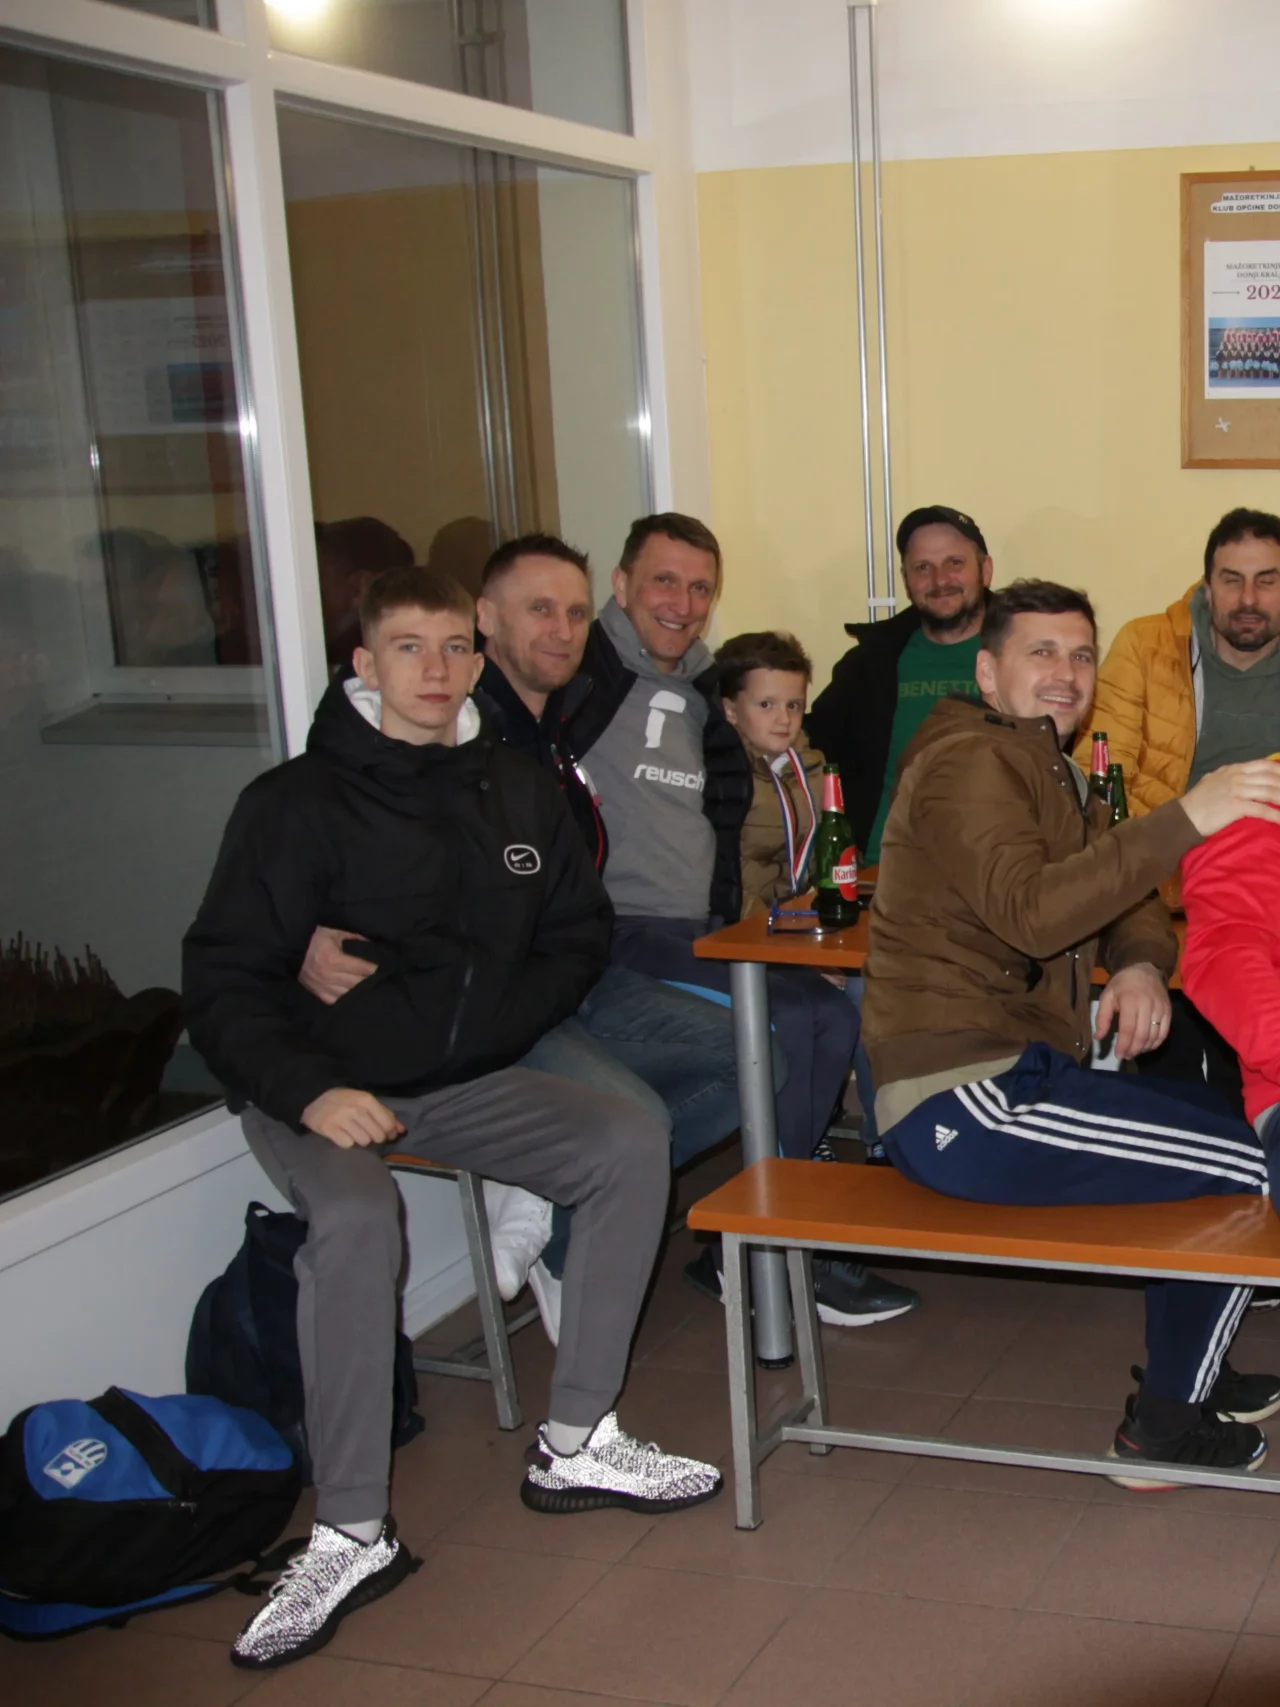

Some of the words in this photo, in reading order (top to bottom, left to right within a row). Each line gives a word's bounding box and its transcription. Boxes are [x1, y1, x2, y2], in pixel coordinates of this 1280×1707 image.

[1236, 271, 1259, 279] DONJI
[633, 763, 705, 792] reusch
[937, 1129, 959, 1151] adidas
